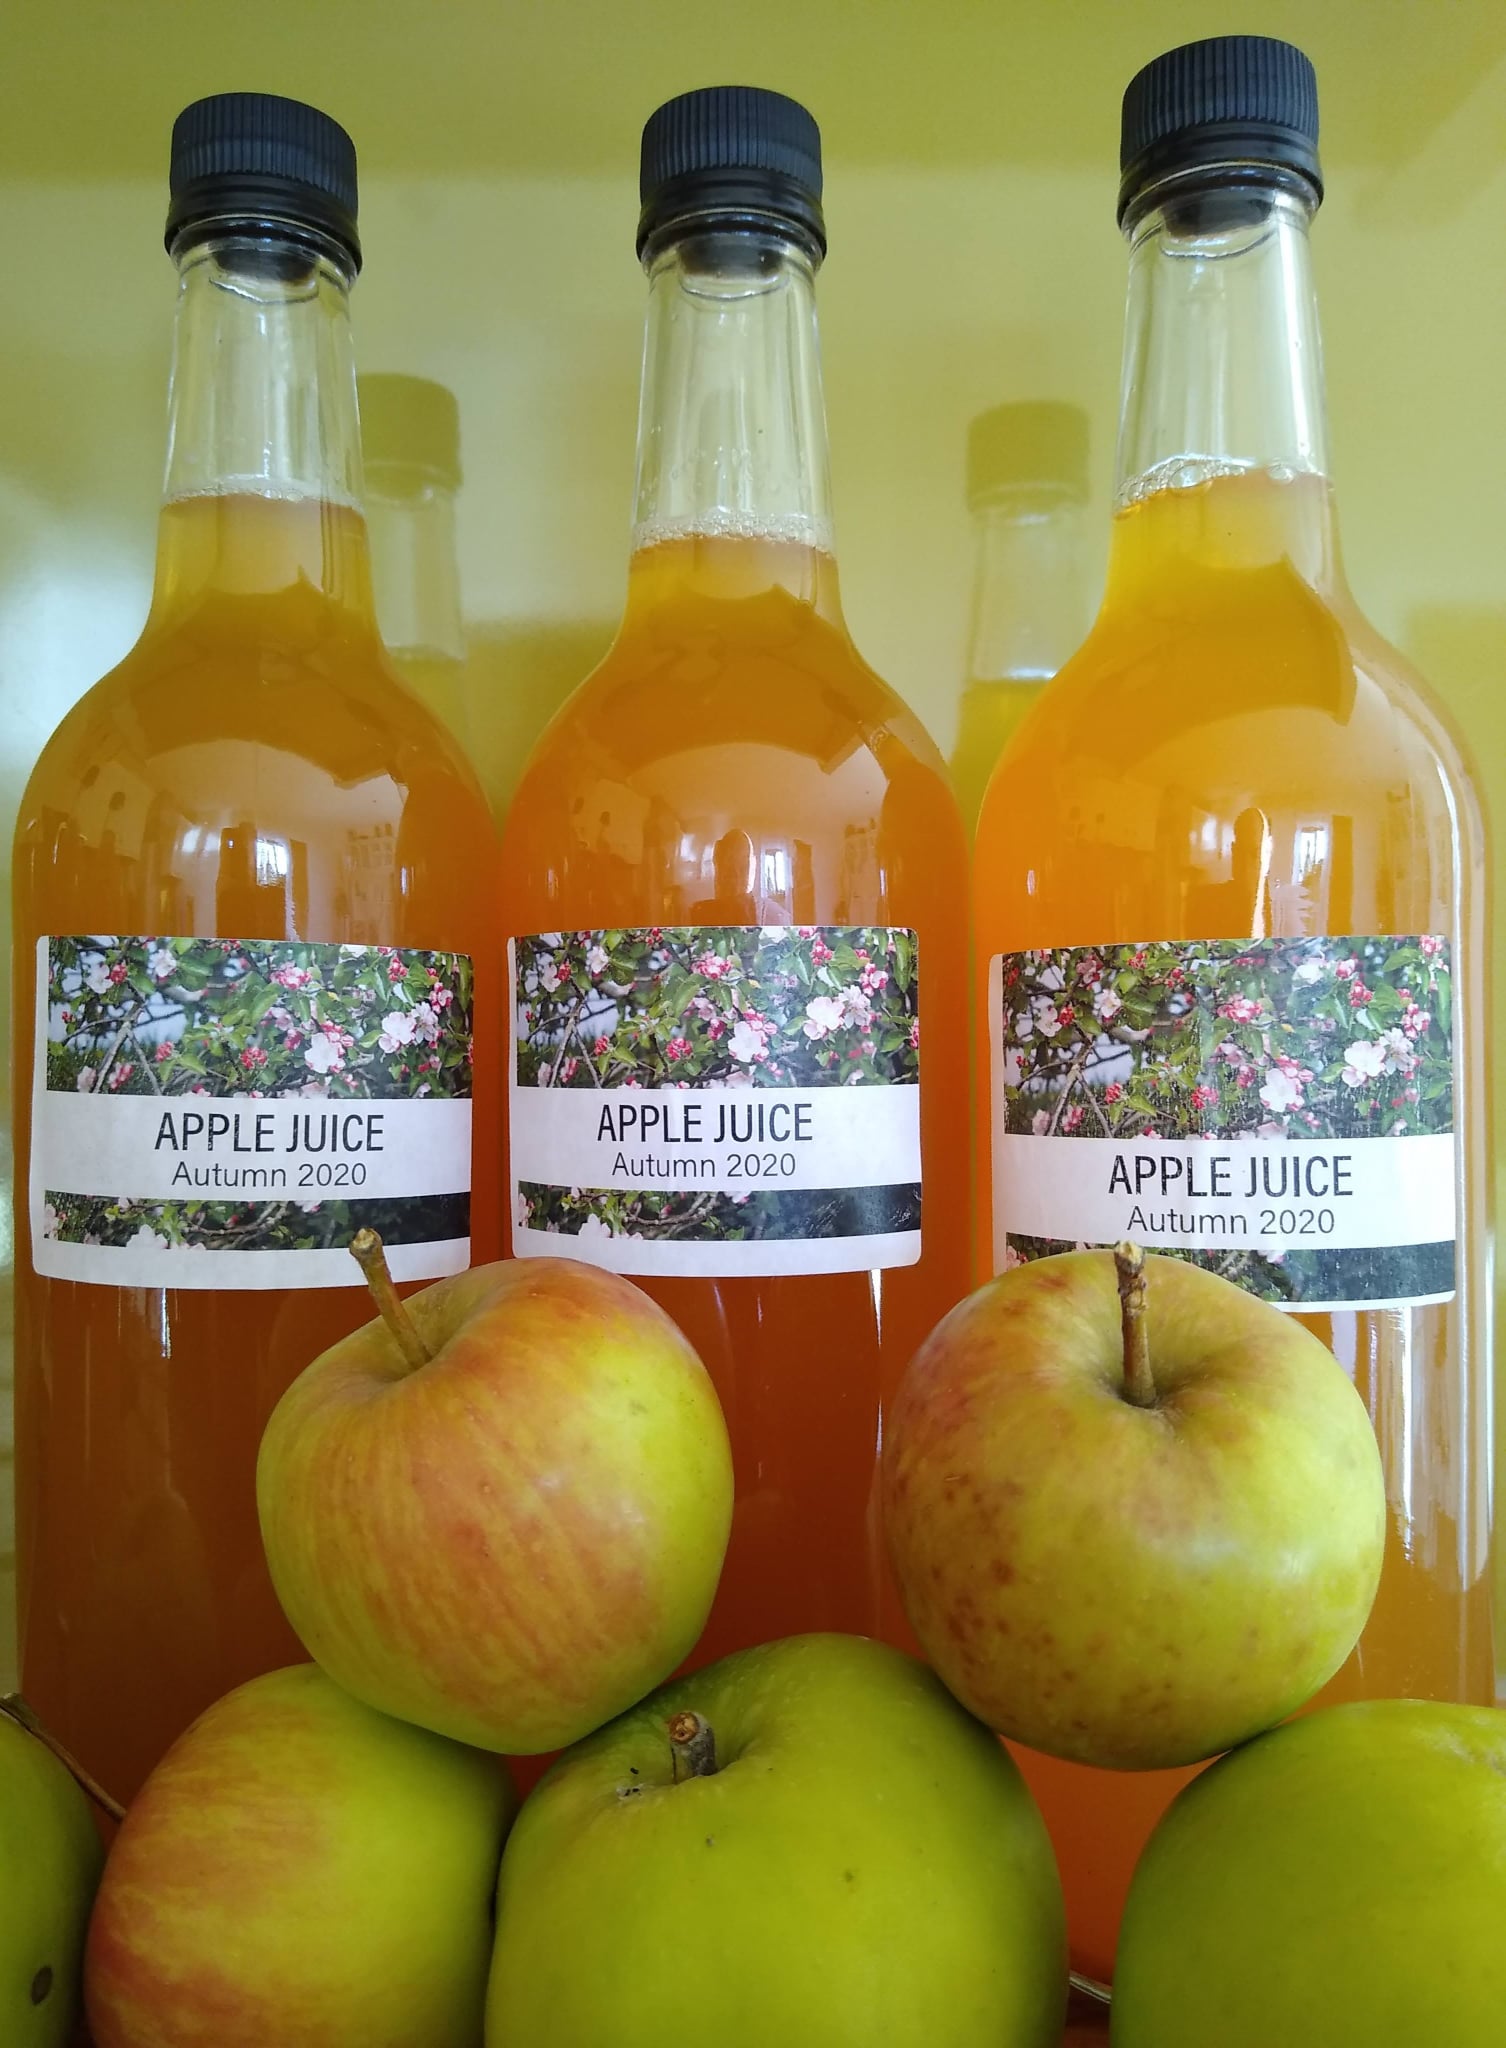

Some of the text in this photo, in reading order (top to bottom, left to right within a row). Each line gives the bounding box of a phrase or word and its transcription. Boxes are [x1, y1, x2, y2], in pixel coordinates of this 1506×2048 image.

[154, 1111, 384, 1153] APPLE JUICE
[597, 1103, 813, 1143] APPLE JUICE
[171, 1161, 367, 1188] Autumn 2020
[611, 1151, 796, 1178] Autumn 2020
[1108, 1154, 1353, 1198] APPLE JUICE
[1126, 1205, 1335, 1235] Autumn 2020
